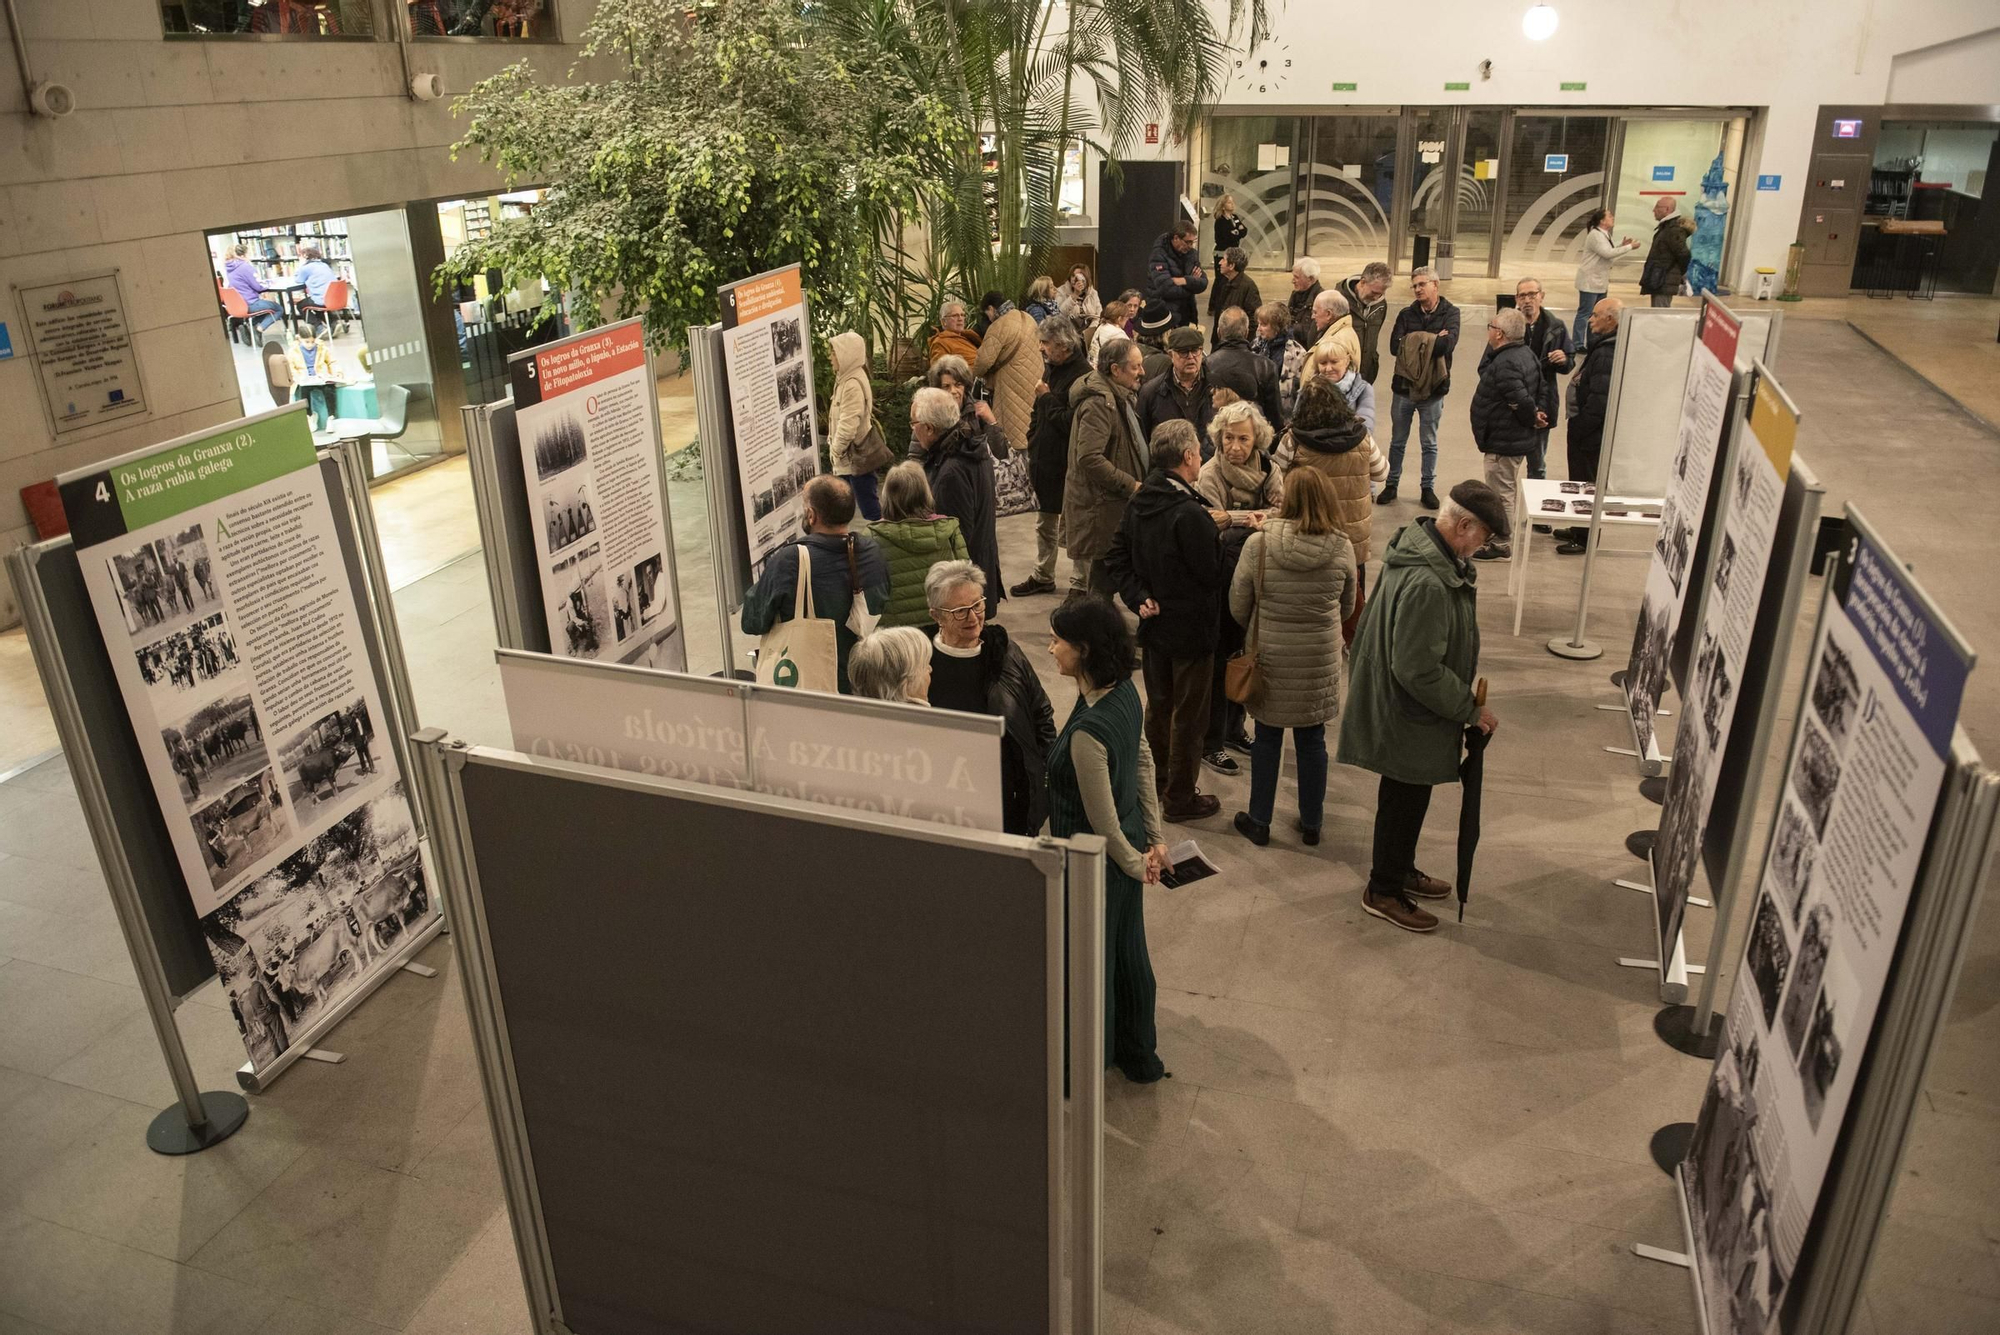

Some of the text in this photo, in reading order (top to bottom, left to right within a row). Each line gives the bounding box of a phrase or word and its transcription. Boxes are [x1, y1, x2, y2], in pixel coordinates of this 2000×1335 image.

[730, 294, 735, 307] 6
[541, 358, 549, 367] Os
[551, 351, 570, 364] logros
[571, 347, 579, 356] da
[579, 342, 601, 355] Granxa
[542, 369, 552, 379] Un
[553, 365, 568, 376] novo
[568, 359, 586, 369] millo,
[591, 350, 612, 364] lúpulo,
[616, 340, 639, 355] Estación
[527, 362, 536, 379] 5
[544, 368, 593, 391] de Fitopatoloxía
[120, 432, 256, 487] Os logros da Granxa (2).
[95, 481, 110, 503] 4
[125, 457, 234, 503] A raza rubia galega
[229, 517, 250, 528] consenso
[251, 509, 271, 519] bastante
[272, 500, 293, 511] estendido
[269, 510, 292, 521] necesidade
[293, 501, 313, 512] recuperar
[216, 518, 231, 544] A
[221, 550, 240, 561] aptitude
[241, 544, 253, 553] (para
[226, 564, 251, 578] exemplares
[288, 543, 302, 551] outros
[251, 545, 276, 558] partidarios
[228, 572, 255, 586] estranxeiras
[231, 586, 246, 595] outros
[247, 573, 274, 588] especialistas
[276, 565, 294, 575] optaban
[303, 553, 318, 563] escoller
[233, 590, 259, 604] exemplares
[287, 566, 310, 579] encaixaban
[238, 608, 259, 620] favorecer
[272, 590, 300, 604] cruzamento
[280, 609, 298, 618] Granxa
[321, 588, 338, 599] Monelos
